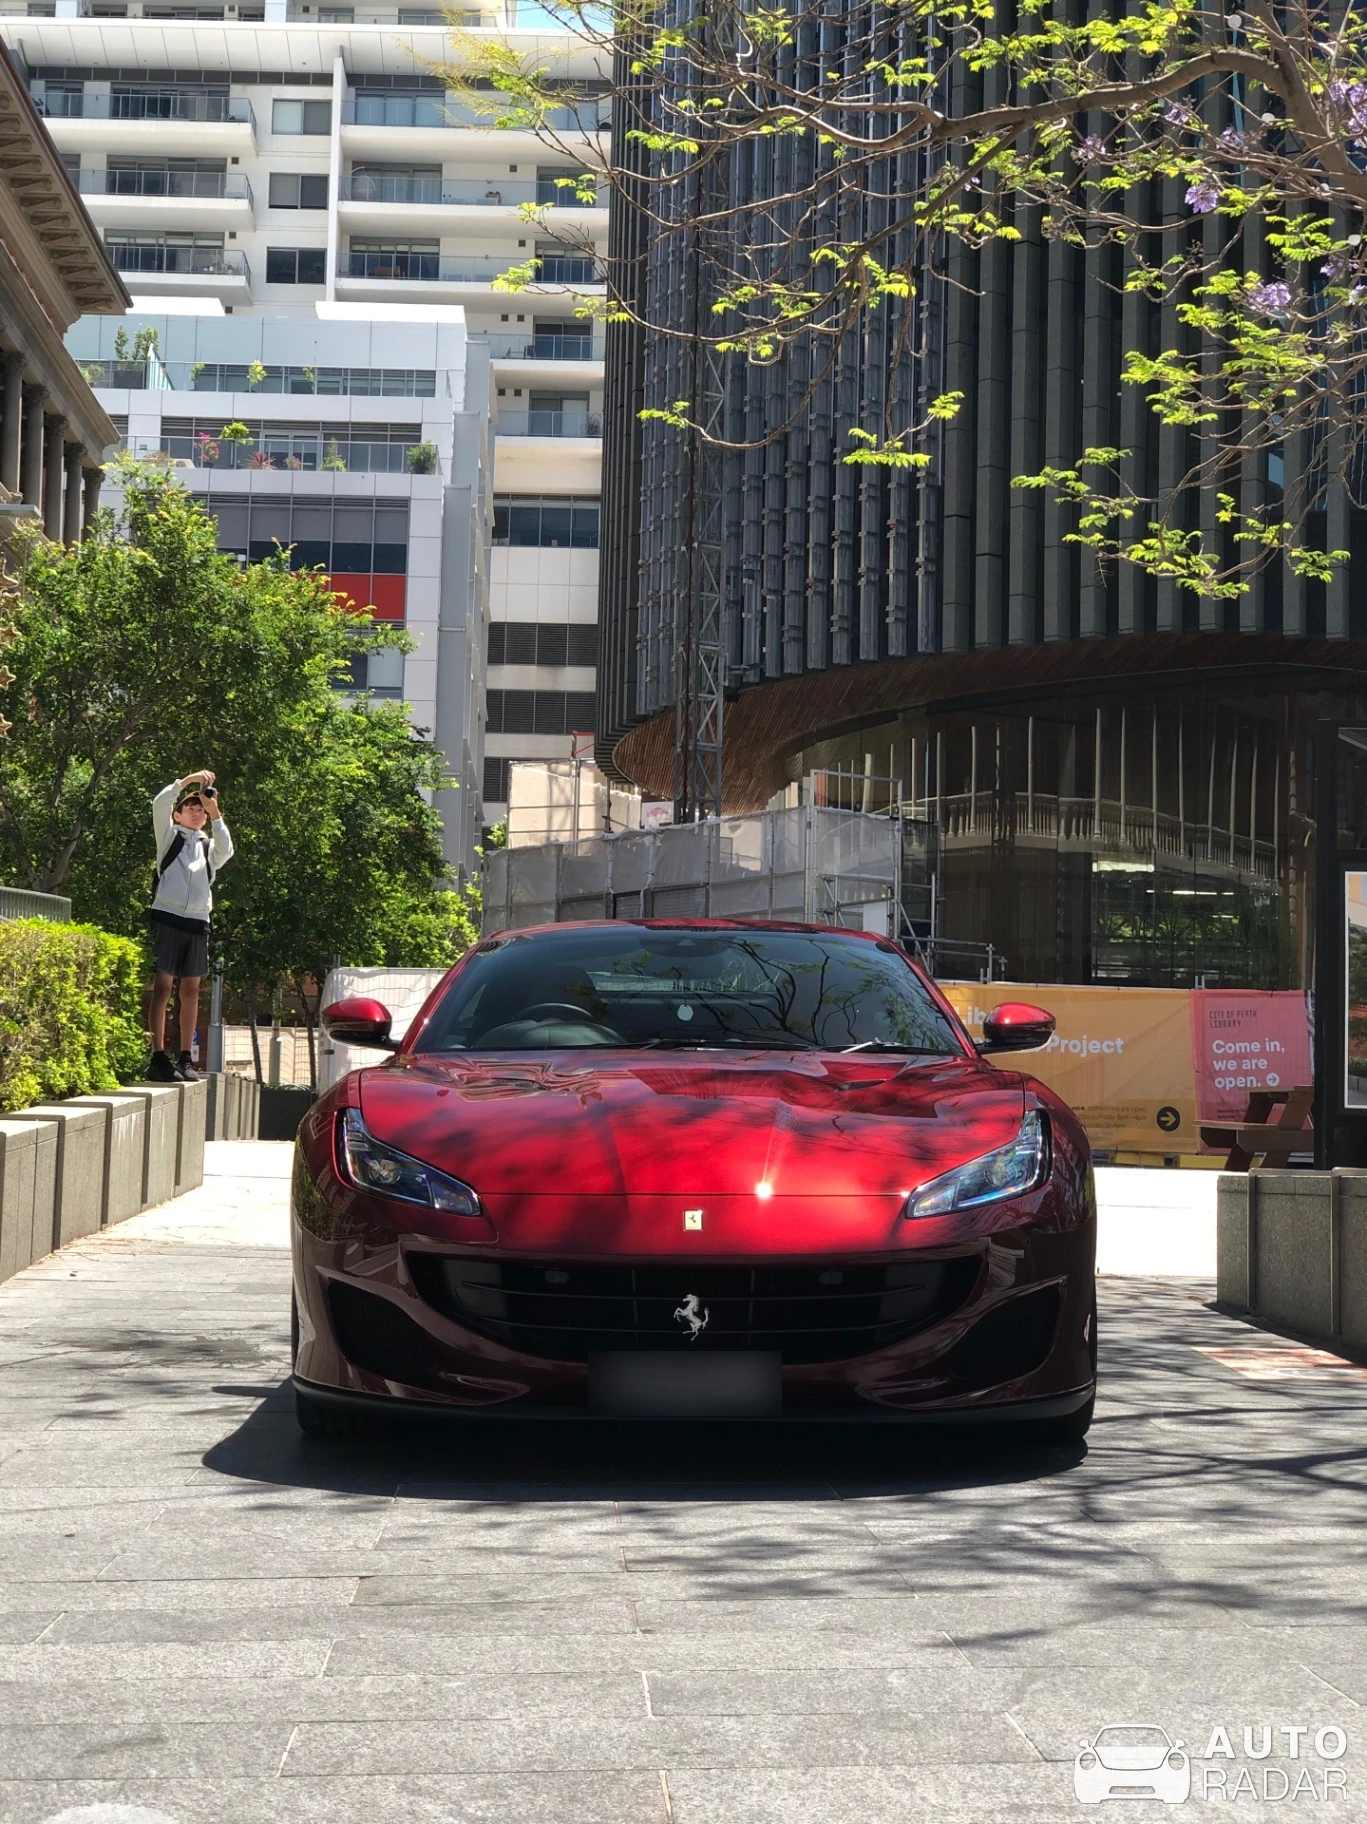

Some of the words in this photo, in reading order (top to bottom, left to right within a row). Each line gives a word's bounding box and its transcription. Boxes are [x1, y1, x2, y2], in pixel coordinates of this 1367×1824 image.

[1209, 1010, 1224, 1019] CITY
[1226, 1010, 1235, 1018] OF
[1236, 1009, 1257, 1018] PERTH
[1209, 1019, 1242, 1029] LIBRARY
[1046, 1034, 1124, 1057] Project
[1212, 1039, 1261, 1054] Come
[1264, 1037, 1285, 1054] in,
[1212, 1059, 1238, 1071] we
[1241, 1058, 1268, 1070] are
[1214, 1076, 1262, 1091] open.
